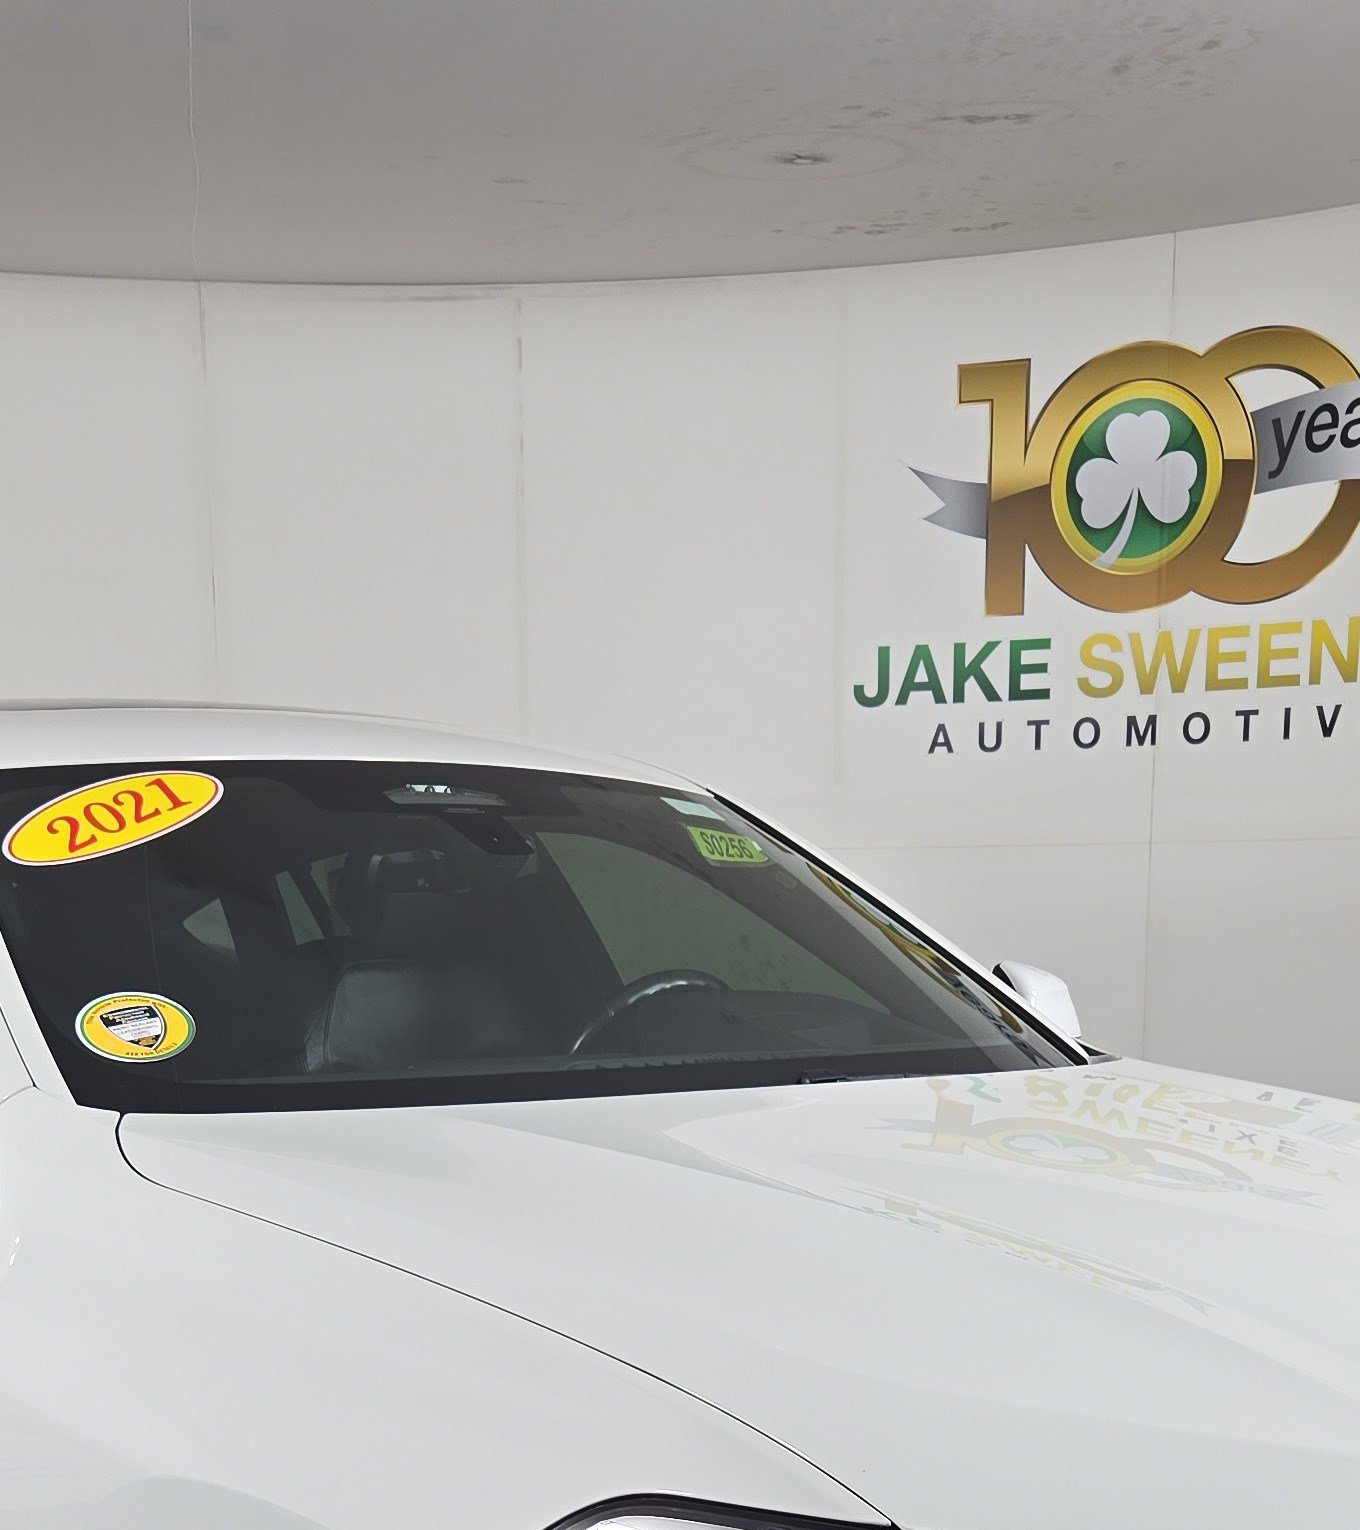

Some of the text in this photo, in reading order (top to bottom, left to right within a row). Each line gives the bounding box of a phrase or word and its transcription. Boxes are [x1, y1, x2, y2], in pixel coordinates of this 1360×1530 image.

[853, 637, 1052, 709] JAKE
[47, 777, 193, 853] 2021
[700, 831, 754, 859] S0256
